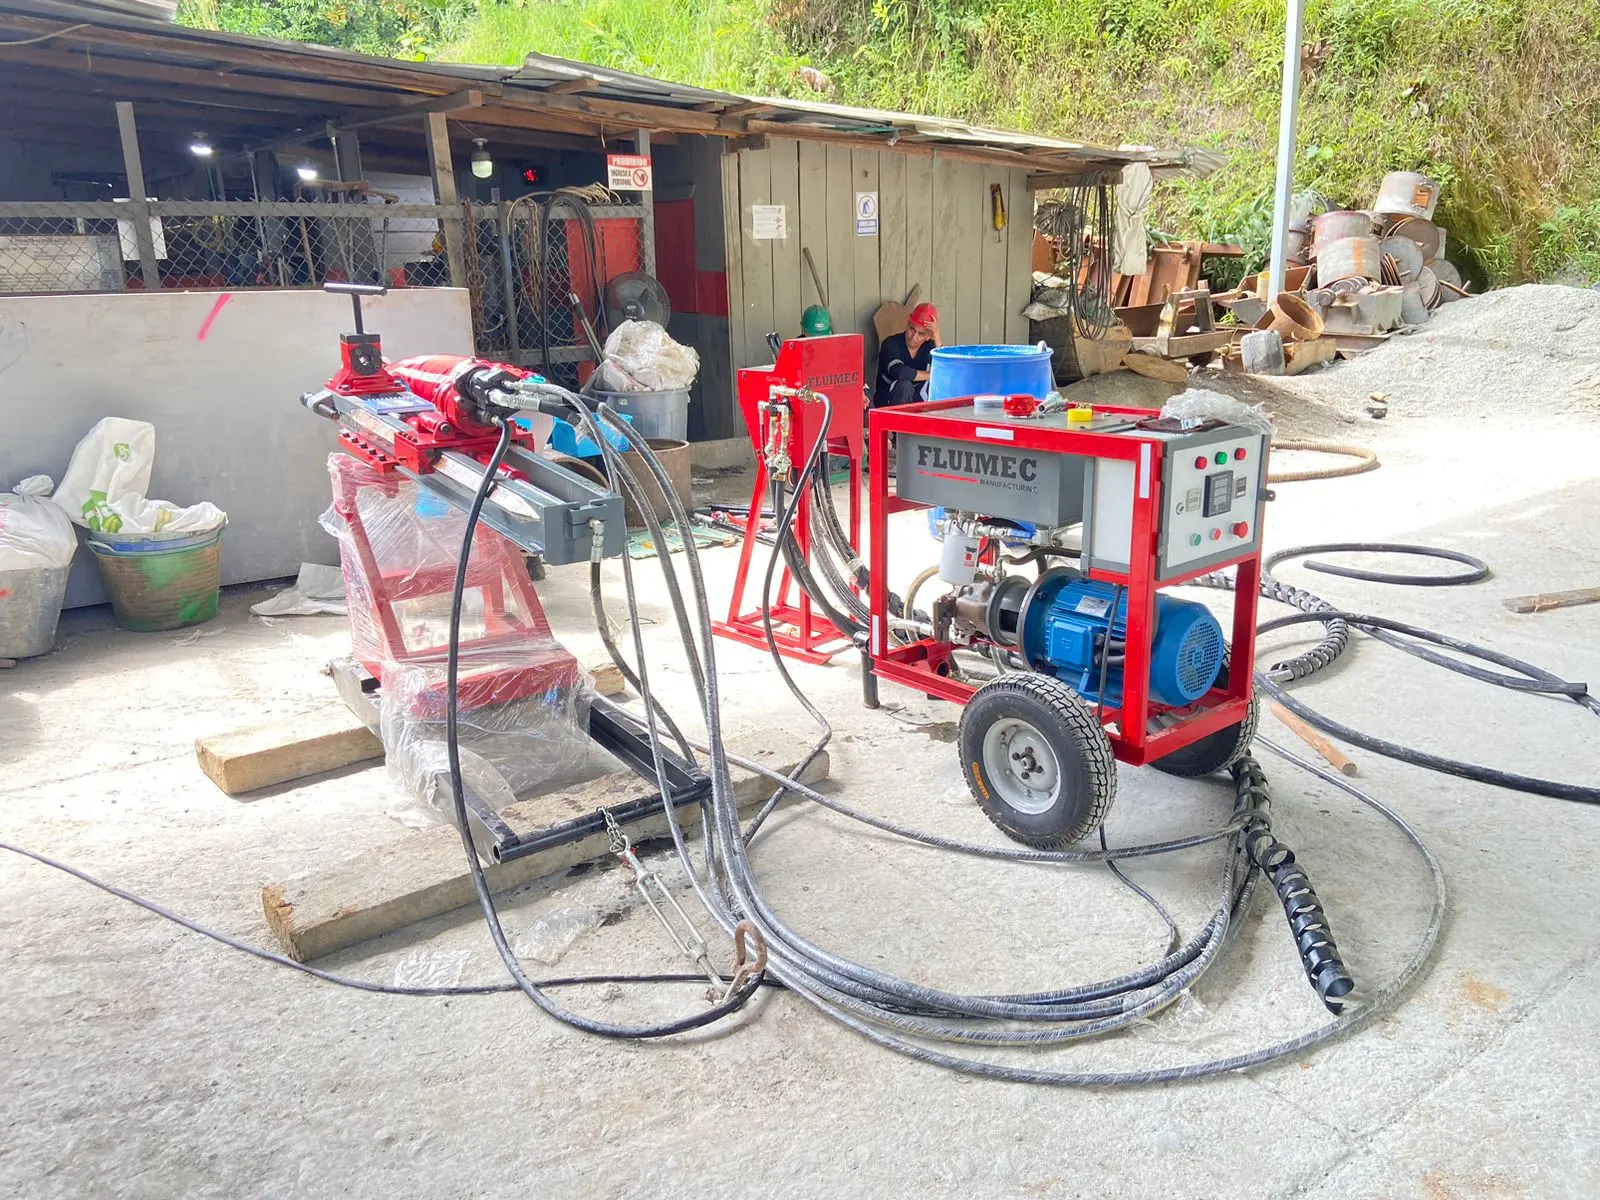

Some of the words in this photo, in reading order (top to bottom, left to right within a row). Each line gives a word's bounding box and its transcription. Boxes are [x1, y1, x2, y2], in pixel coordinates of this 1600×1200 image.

[611, 157, 648, 167] PROHIBIDO
[807, 371, 859, 388] FLUIMEC
[917, 445, 1037, 482] FLUIMEC
[979, 478, 1039, 494] MANUFACTURING
